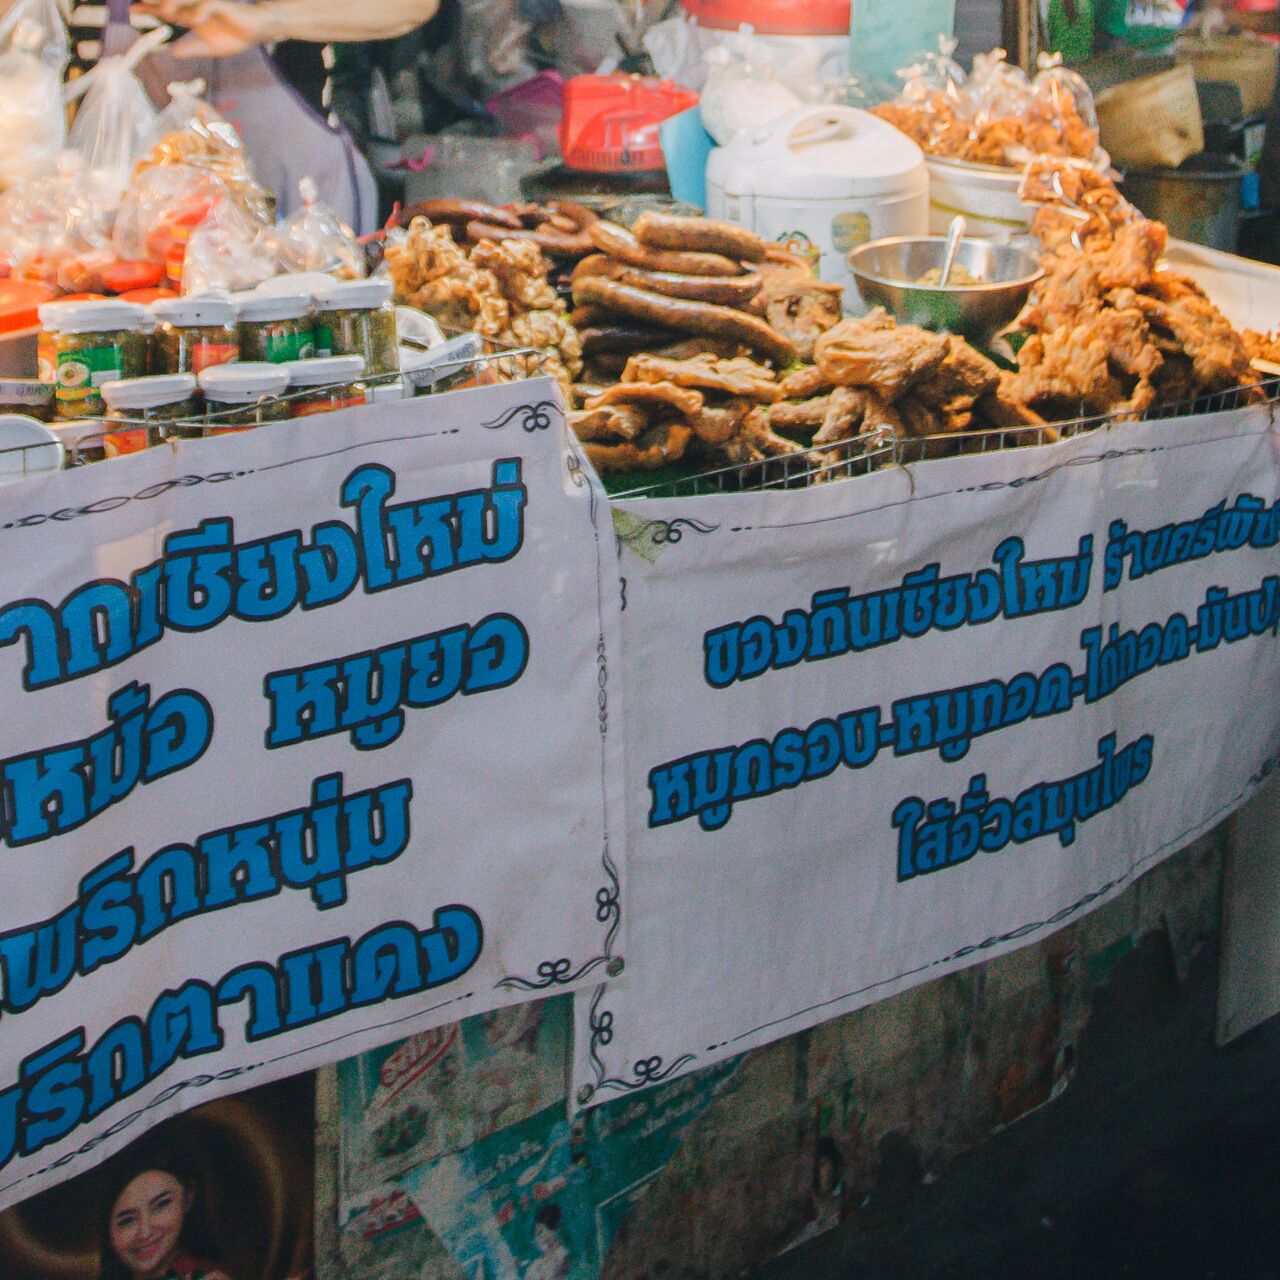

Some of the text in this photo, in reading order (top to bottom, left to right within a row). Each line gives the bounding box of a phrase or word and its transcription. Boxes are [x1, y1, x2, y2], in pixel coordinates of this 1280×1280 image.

[263, 611, 531, 751] หมูยอ
[703, 536, 1095, 688] ของกินเชียงใหม่
